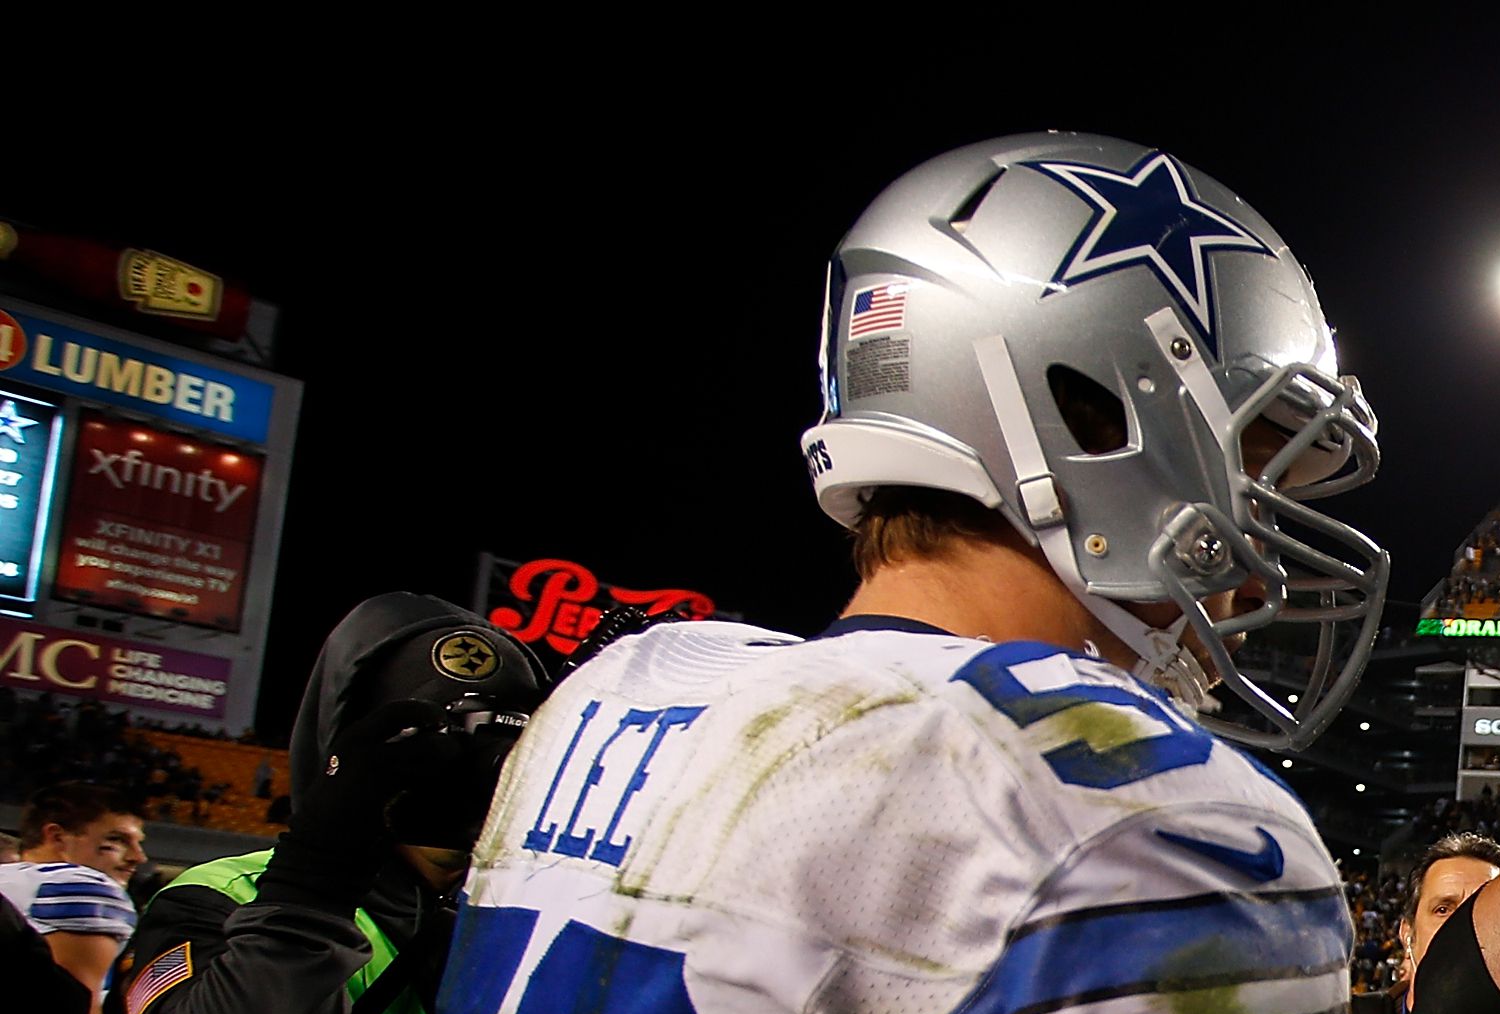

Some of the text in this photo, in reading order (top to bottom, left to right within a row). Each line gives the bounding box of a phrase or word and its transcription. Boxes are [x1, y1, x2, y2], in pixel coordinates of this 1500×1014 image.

[32, 334, 236, 422] LUMBER
[89, 448, 247, 512] xfinity
[95, 520, 190, 551] XFINITY
[75, 554, 111, 569] you
[207, 577, 231, 593] TV
[111, 648, 163, 669] LIFE
[109, 663, 227, 696] CHANGING
[109, 679, 215, 709] MEDICINE
[495, 714, 528, 727] Nikon
[523, 698, 709, 867] LEE
